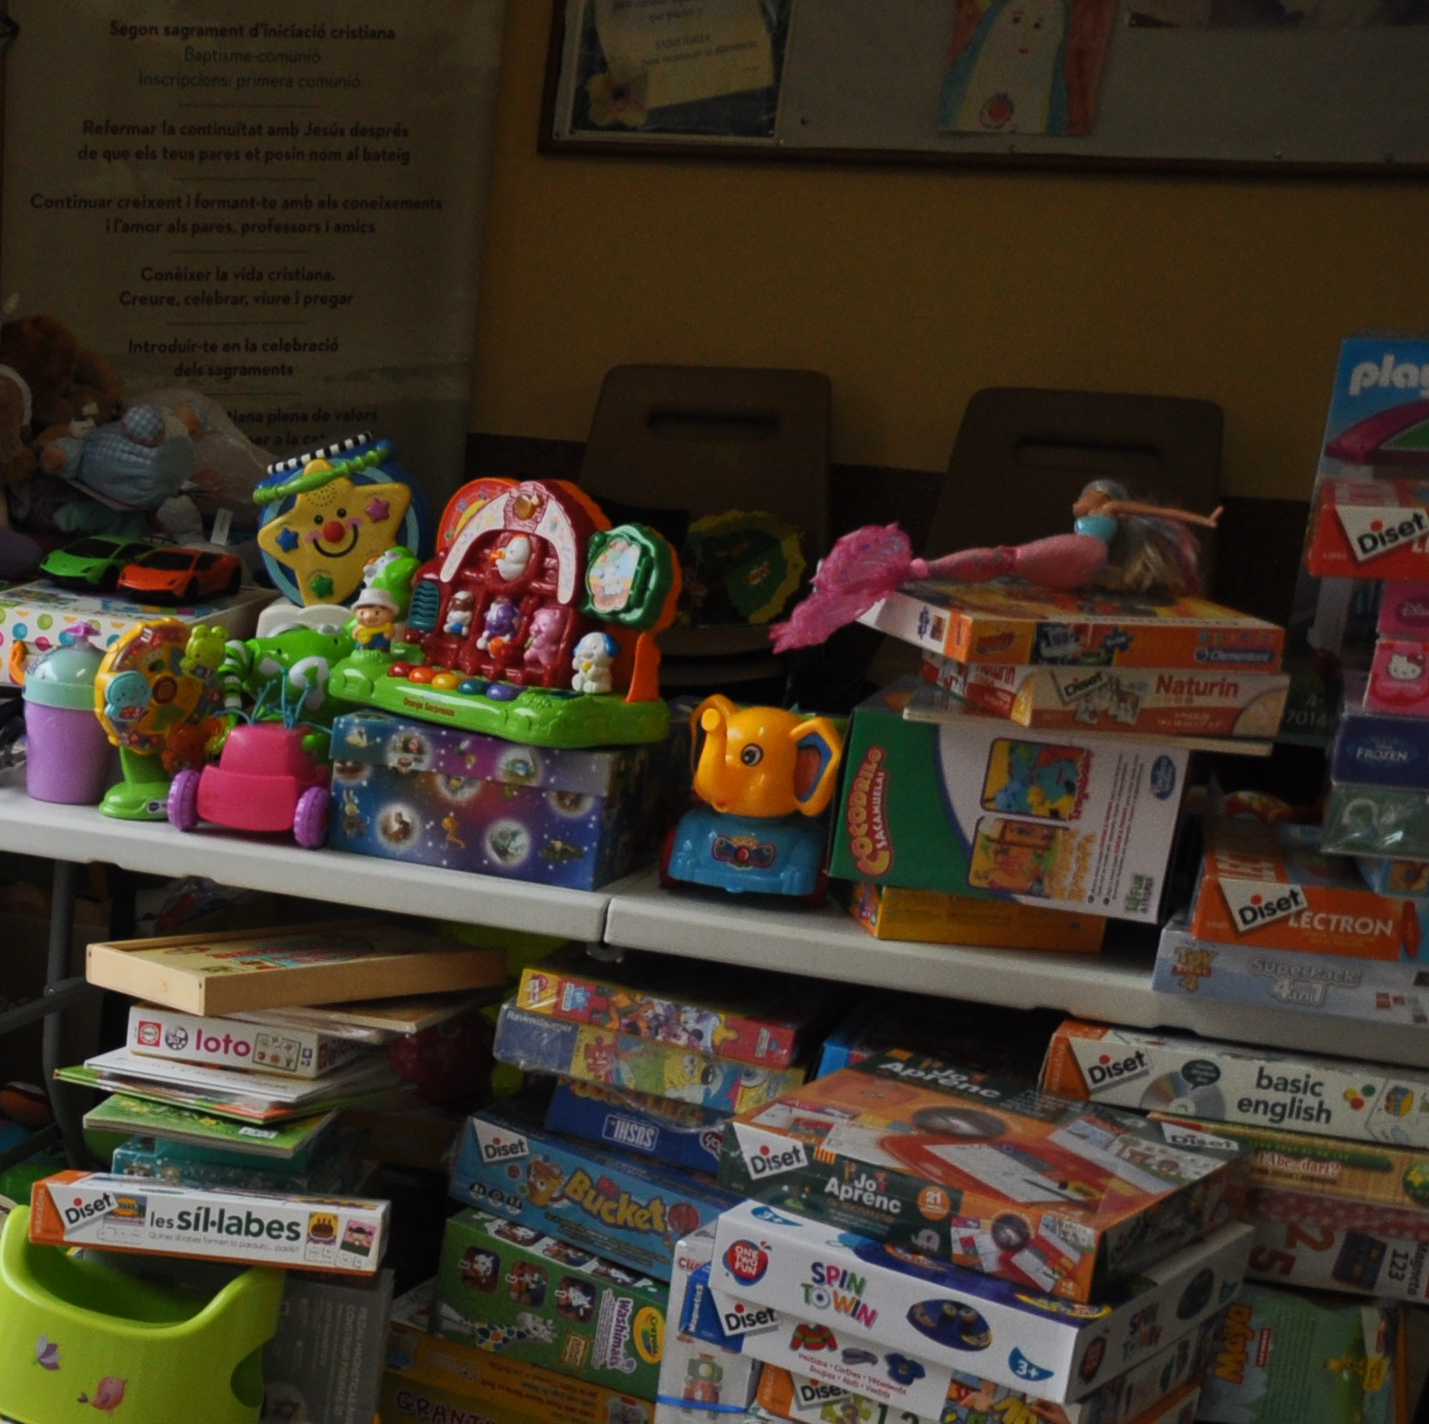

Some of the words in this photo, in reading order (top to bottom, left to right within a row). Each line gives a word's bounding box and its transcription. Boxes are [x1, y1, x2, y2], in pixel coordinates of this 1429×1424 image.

[109, 21, 158, 39] Segon
[164, 24, 245, 40] sagrament
[250, 21, 326, 40] d'iniciació
[331, 25, 396, 40] cristiana
[184, 48, 321, 67] Baptisme-comunió
[237, 74, 293, 90] primera
[298, 73, 360, 91] comunió
[83, 121, 156, 136] Refermar
[162, 121, 176, 136] la
[267, 122, 299, 137] amb
[304, 122, 345, 138] Jesús
[350, 122, 409, 142] després
[78, 145, 97, 161] de
[103, 148, 130, 165] que
[135, 145, 157, 161] els
[162, 146, 194, 161] teus
[199, 148, 240, 166] pares
[245, 146, 260, 161] et
[265, 145, 305, 166] posin
[310, 149, 341, 161] nom
[346, 145, 359, 162] al
[363, 146, 411, 166] bateig
[30, 194, 112, 210] Continuar
[117, 194, 181, 210] creixent
[195, 194, 277, 211] formant-te
[281, 196, 312, 211] amb
[317, 196, 338, 211] els
[342, 197, 442, 211] coneixements
[114, 220, 162, 234] l'amor
[167, 220, 188, 235] als
[241, 220, 321, 239] professors
[333, 220, 376, 235] amics
[141, 267, 211, 282] Conèixer
[216, 267, 229, 282] la
[233, 267, 263, 282] vida
[119, 291, 179, 307] Creure,
[184, 291, 249, 307] celebrar,
[253, 291, 290, 306] viure
[303, 293, 353, 310] pregar
[128, 338, 217, 354] Introduir-te
[222, 342, 240, 354] en
[245, 338, 258, 353] la
[262, 338, 339, 353] celebració
[174, 362, 204, 377] dels
[207, 363, 293, 380] sagraments
[268, 408, 307, 427] plena
[311, 408, 330, 423] de
[334, 408, 378, 423] valors
[1357, 513, 1427, 555] Diset
[1064, 670, 1105, 698] Diset
[1155, 674, 1238, 698] Naturin
[1355, 745, 1408, 763] FROZEN
[848, 749, 892, 876] COCODRILO
[1238, 889, 1301, 927] Diset
[1288, 911, 1393, 937] LECTRON
[505, 1009, 572, 1035] Ravensburger
[195, 1029, 251, 1058] loto
[878, 1059, 1001, 1099] Aprenc
[1088, 1051, 1146, 1085] Diset
[1256, 1066, 1324, 1098] basic
[1237, 1094, 1332, 1125] english
[608, 1120, 654, 1148] SUSHI
[1170, 1132, 1233, 1151] Diset
[483, 1139, 527, 1161] Diset
[751, 1146, 803, 1176] Diset
[853, 1172, 876, 1191] Jo
[565, 1166, 667, 1234] Bucket
[824, 1176, 902, 1214] Aprenc
[64, 1191, 114, 1226] Diset
[150, 1210, 174, 1230] les
[733, 1244, 759, 1259] ONE
[734, 1253, 756, 1269] TWO
[733, 1261, 758, 1277] FUN
[811, 1262, 866, 1292] SPIN
[1387, 1249, 1409, 1284] 123
[724, 1308, 777, 1332] Diset
[610, 1296, 634, 1371] Washimals
[645, 1315, 661, 1356] Crayola
[1215, 1306, 1250, 1383] Maya
[834, 1362, 865, 1379] Clothes
[1014, 1358, 1040, 1380] 3+
